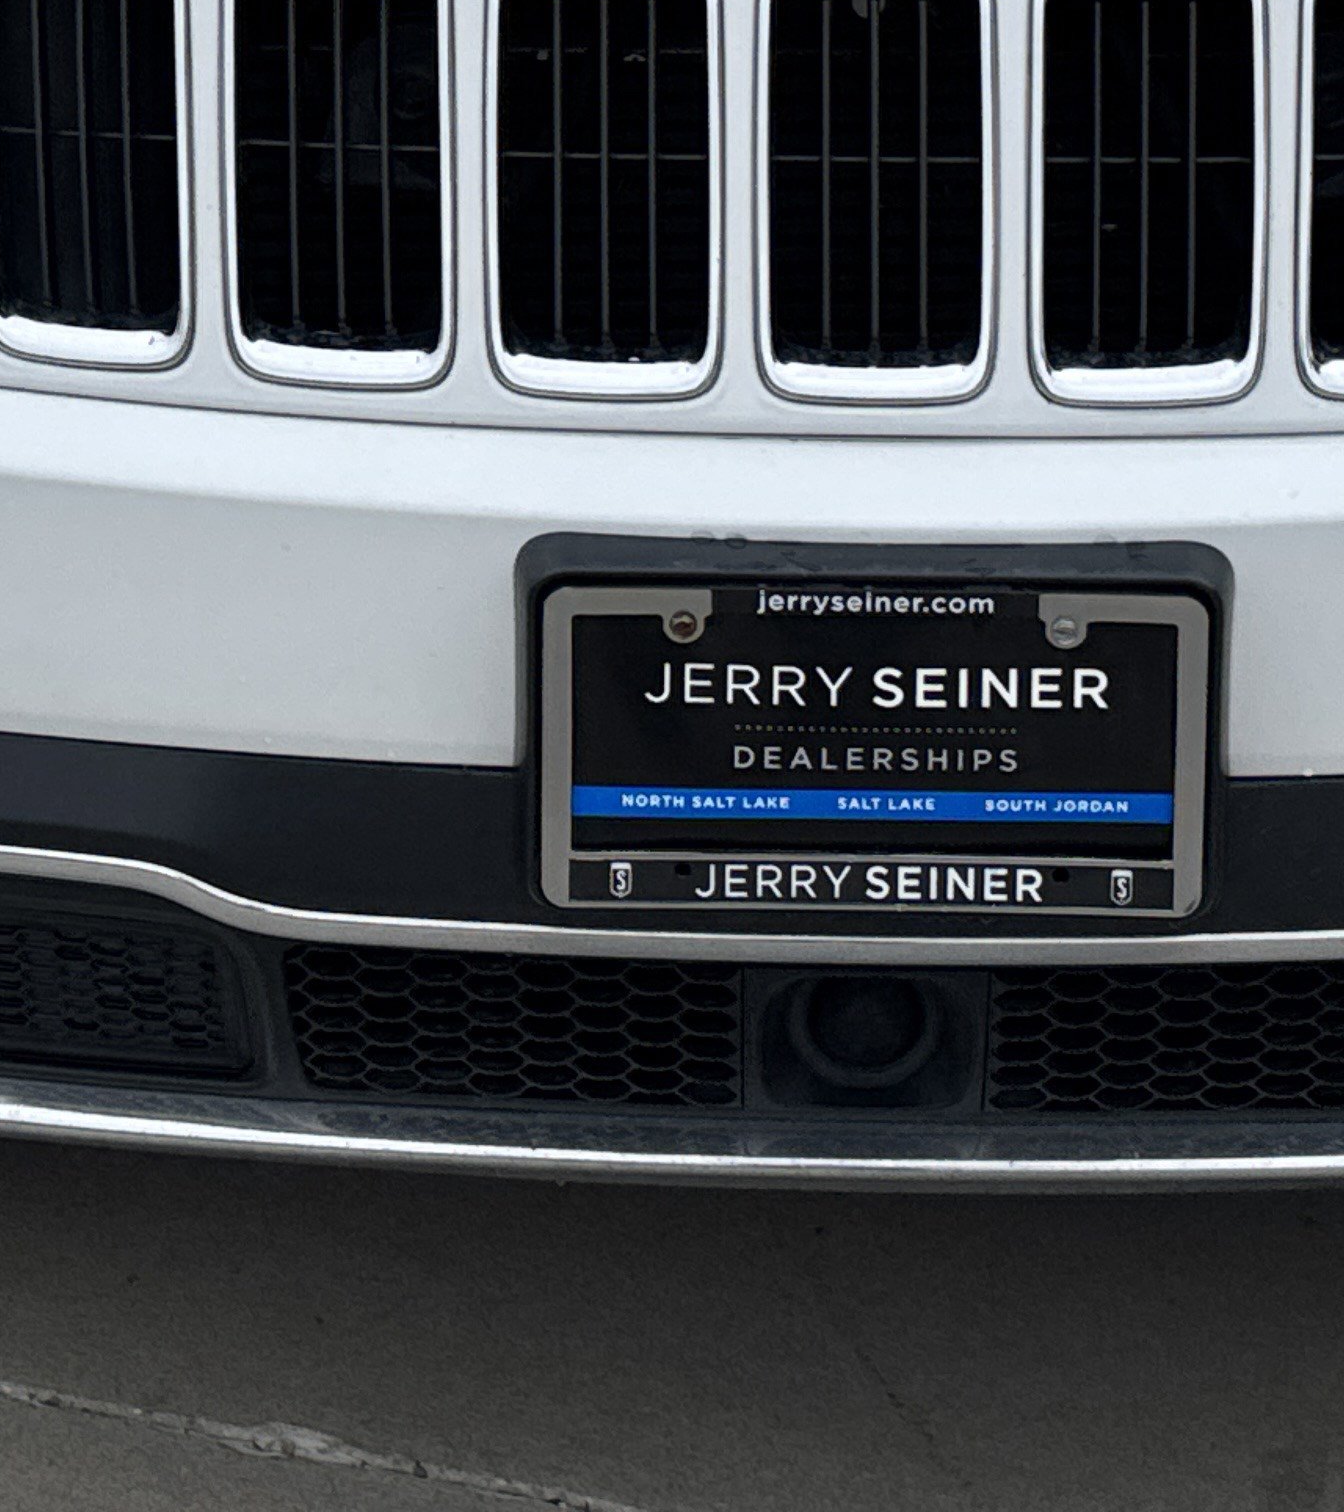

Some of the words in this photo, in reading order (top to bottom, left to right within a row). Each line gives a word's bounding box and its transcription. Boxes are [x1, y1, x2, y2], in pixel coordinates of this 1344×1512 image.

[756, 588, 996, 616] jerryseiner.com
[643, 661, 854, 707] JERRY
[871, 666, 1110, 710] SEINER
[732, 745, 1019, 773] DEALERSHIPS
[620, 793, 685, 808] NORTH
[691, 795, 737, 809] SALT
[742, 796, 791, 810] LAKE
[837, 796, 882, 810] SALT
[887, 797, 937, 811] LAKE
[984, 798, 1047, 813] SOUTH
[1052, 799, 1130, 814] JORDAN
[694, 863, 852, 899] JERRY
[864, 865, 1044, 903] SEINER
